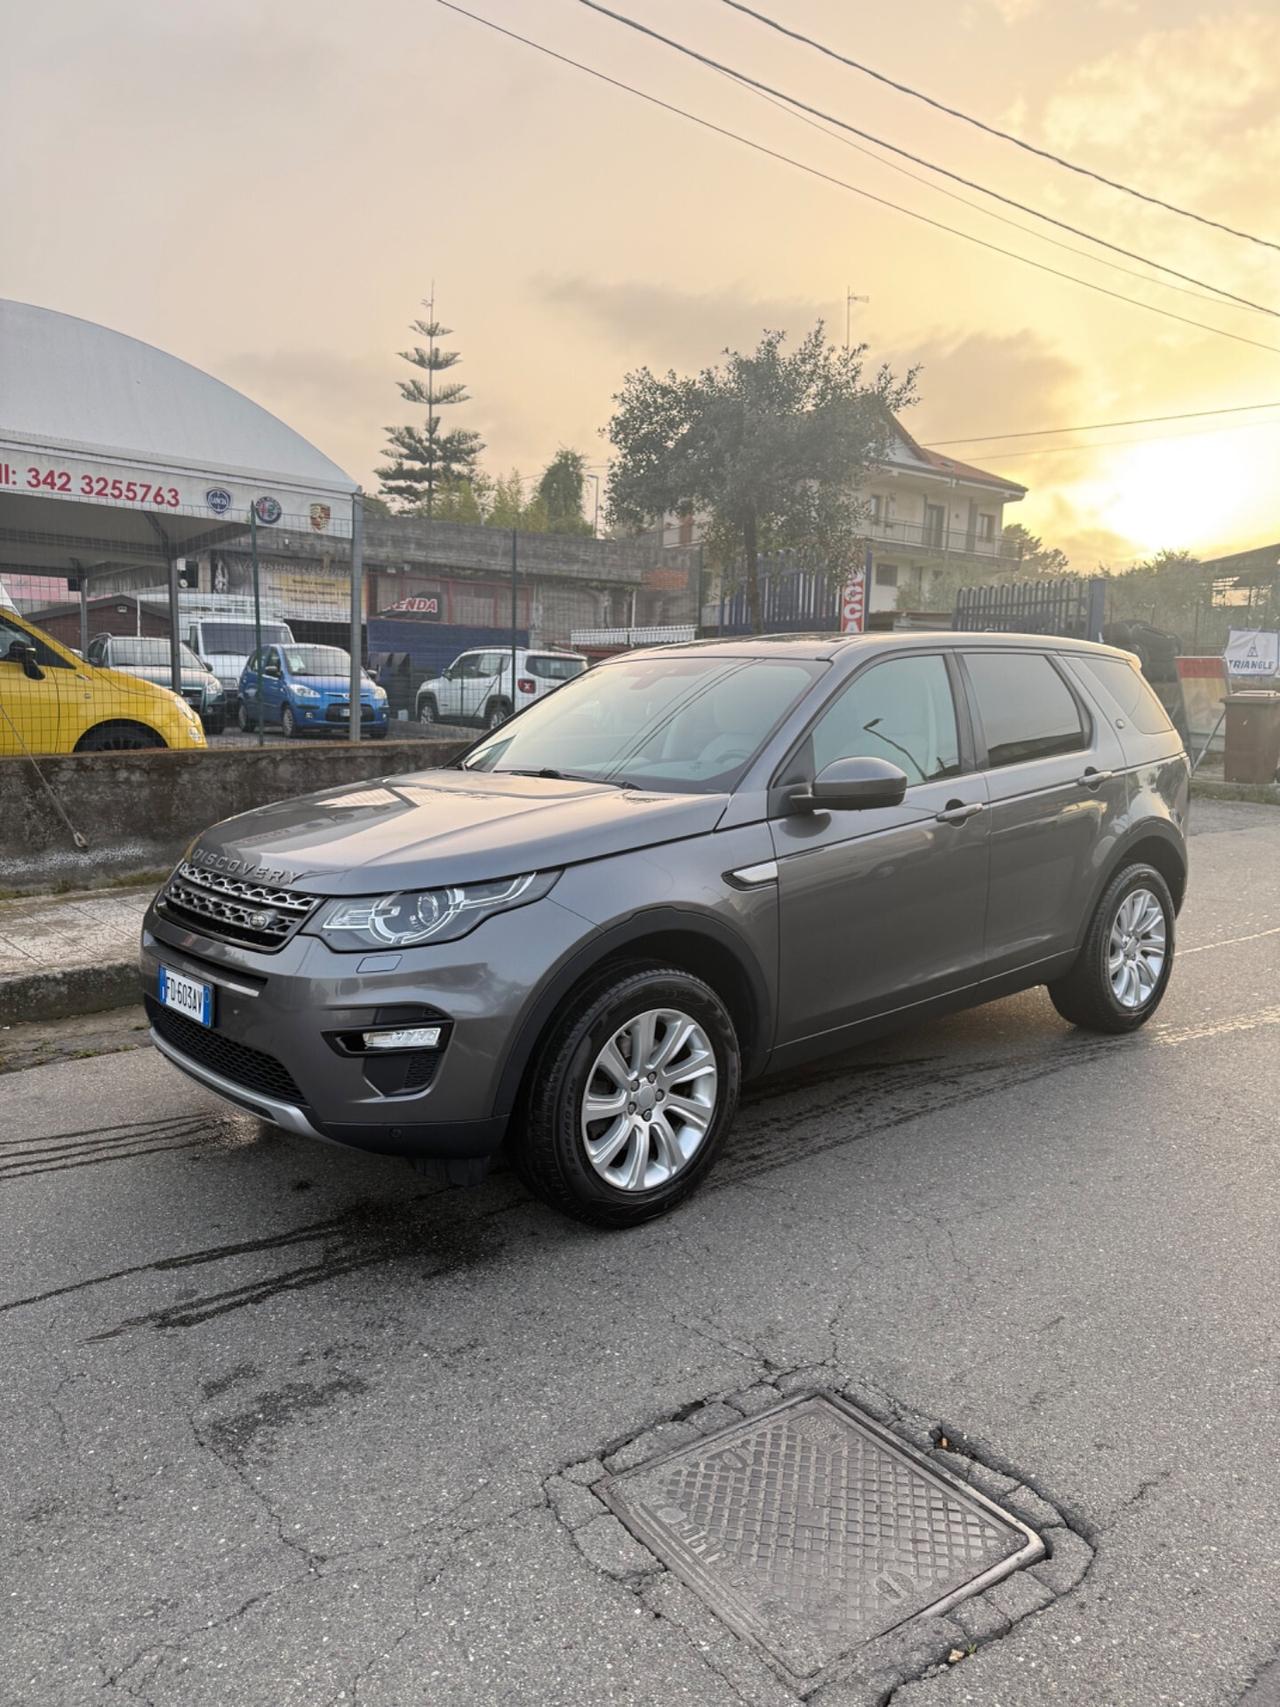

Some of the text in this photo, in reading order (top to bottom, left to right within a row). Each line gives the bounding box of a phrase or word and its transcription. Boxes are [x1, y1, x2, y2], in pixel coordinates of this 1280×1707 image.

[26, 467, 72, 492] 342
[80, 475, 180, 508] 3255763
[1228, 659, 1274, 670] TRIANGLE
[192, 848, 305, 884] DISCOVERY
